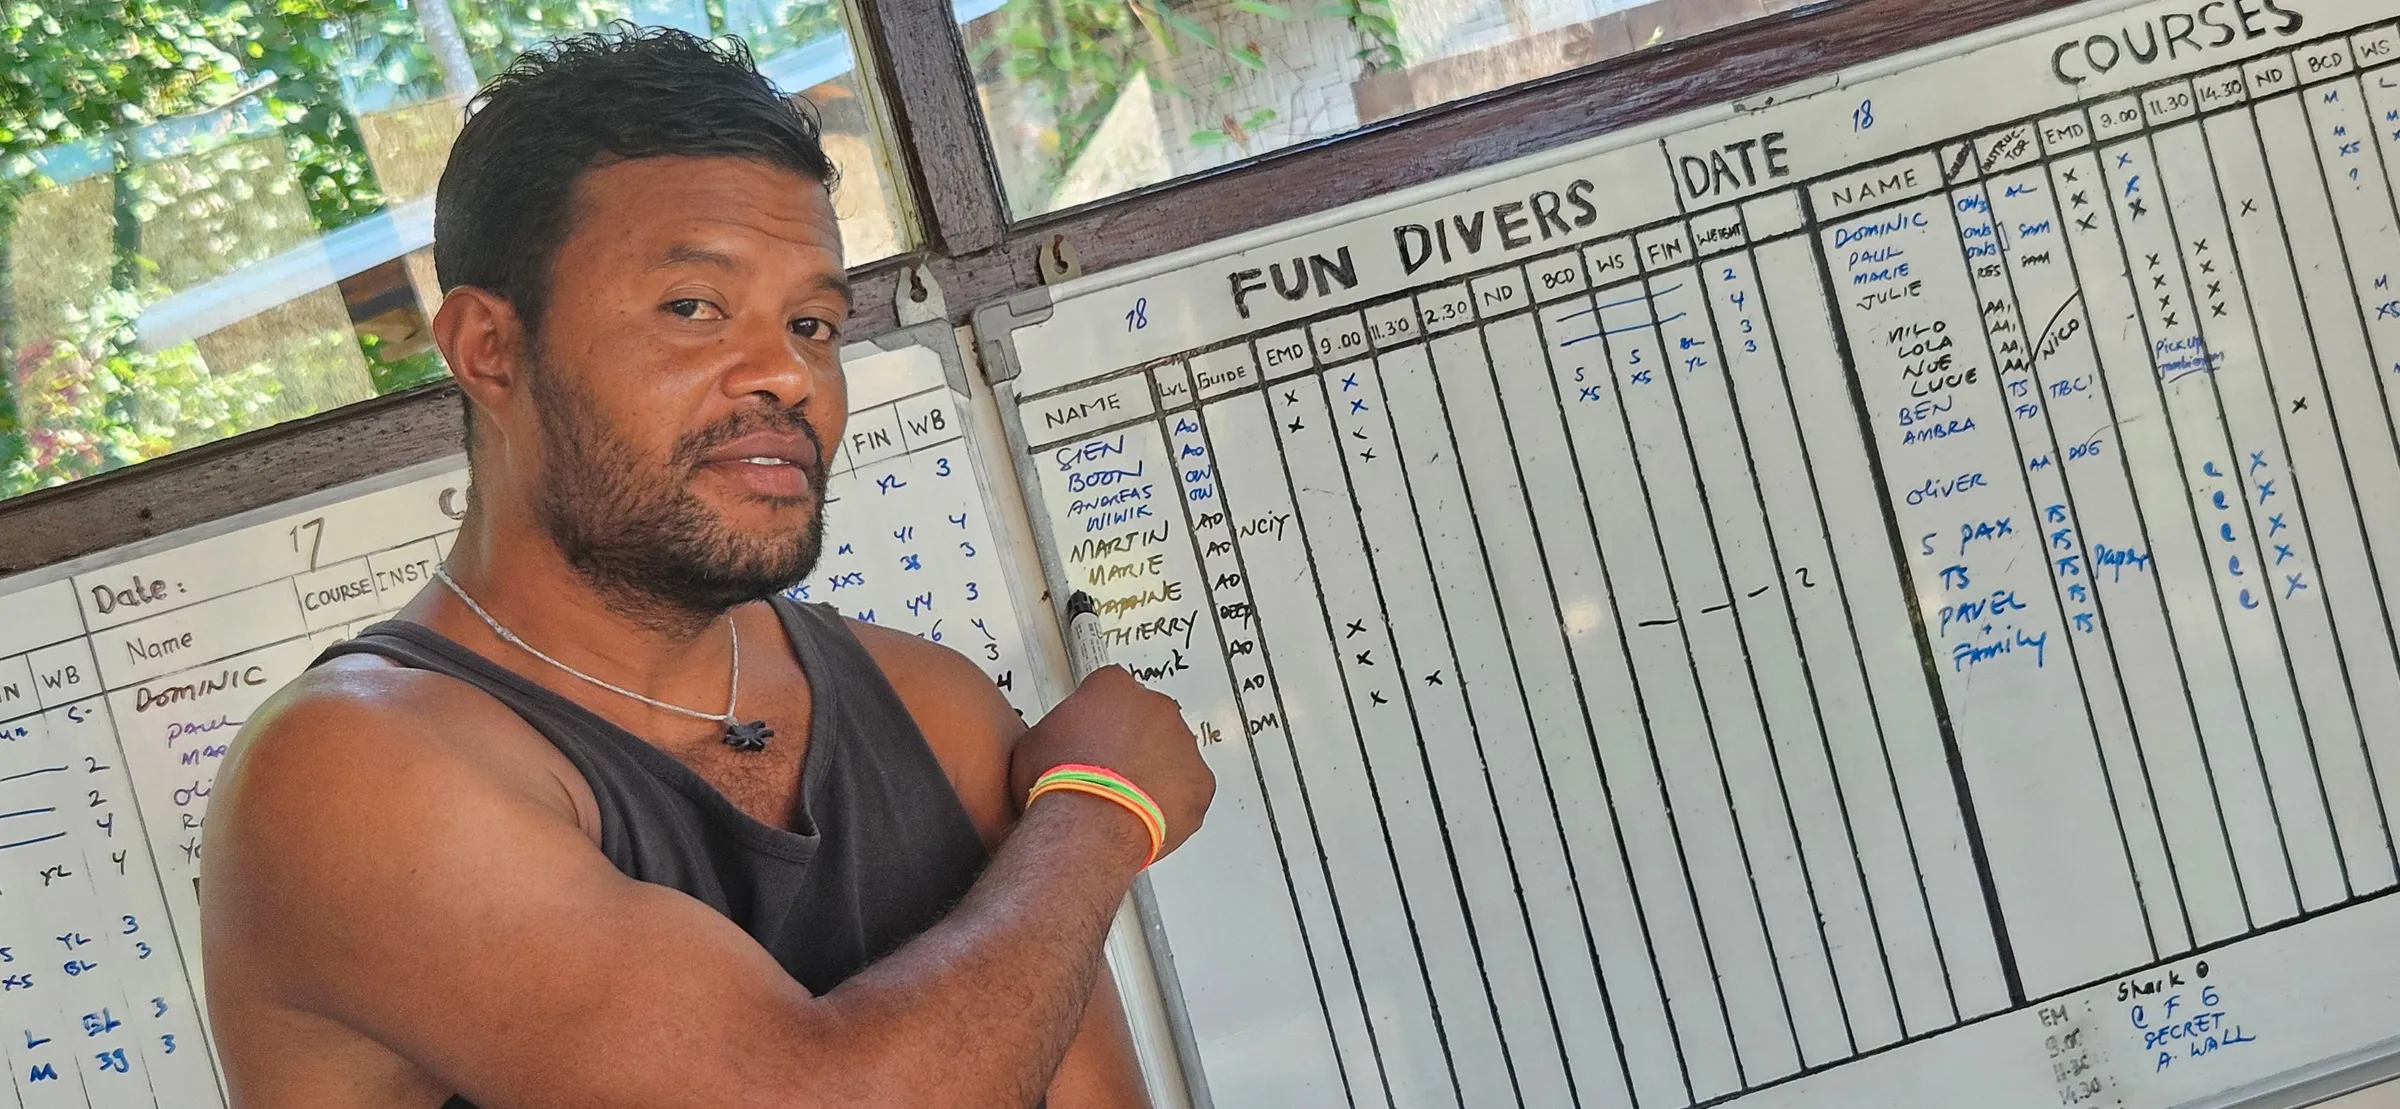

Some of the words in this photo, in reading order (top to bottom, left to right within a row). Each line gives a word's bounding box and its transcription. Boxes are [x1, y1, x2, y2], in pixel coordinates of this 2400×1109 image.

[2051, 0, 2303, 85] COURSES
[2360, 39, 2390, 58] WS
[2308, 52, 2342, 73] BCD
[2255, 69, 2283, 87] ND
[2200, 79, 2242, 103] 14.30
[2323, 90, 2339, 104] M
[2149, 92, 2189, 115] 11.30
[2386, 109, 2399, 121] M
[1853, 99, 1874, 133] 18
[2046, 123, 2083, 145] EMD
[2333, 126, 2346, 137] M
[1679, 130, 1790, 199] DATE
[1831, 169, 1918, 207] NAME
[1834, 212, 1928, 249] DOMINIC
[1227, 245, 1359, 318] FUN
[1393, 178, 1598, 276] DIVERS
[1647, 239, 1682, 264] FIN
[1848, 246, 1903, 272] PAUL
[1596, 258, 1625, 273] WS
[1723, 268, 1736, 281] 2
[1853, 262, 1909, 286] MARIE
[1542, 268, 1575, 289] BCD
[2374, 274, 2388, 291] M
[1484, 285, 1513, 307] ND
[1730, 291, 1745, 311] 4
[1856, 279, 1922, 311] JULIE
[1124, 297, 1148, 333] 18
[1424, 300, 1468, 324] 2.30
[1740, 319, 1752, 333] 3
[1267, 343, 1304, 367] EMD
[1744, 340, 1757, 352] 3
[1898, 335, 1953, 359] LOLA
[1197, 366, 1247, 391] GUIDE
[1579, 386, 1600, 402] XS
[907, 408, 946, 437] WB
[1045, 393, 1121, 429] NAME
[1899, 395, 1952, 426] BEN
[852, 428, 892, 454] FIN
[1903, 417, 1976, 446] AMBRA
[936, 458, 951, 477] 3
[1067, 485, 1153, 518] ANDREAS
[949, 512, 966, 530] 4
[290, 516, 325, 573] 17
[838, 543, 854, 555] M
[960, 541, 976, 558] 3
[1070, 520, 1168, 563] MARTIN
[1089, 554, 1163, 586] MARIE
[304, 578, 373, 611] COURSE
[965, 581, 979, 601] 3
[906, 591, 932, 617] 44
[1938, 590, 2026, 638] PAVEL
[1102, 609, 1198, 650] THIERRY
[126, 632, 193, 665] Name
[984, 643, 999, 661] 3
[41, 665, 80, 688] WB
[997, 669, 1012, 692] 4
[136, 666, 267, 712] DOMINIC
[84, 756, 110, 773] 2
[88, 790, 107, 807] 2
[96, 812, 113, 837] 4
[112, 849, 126, 875] 4
[122, 915, 139, 934] 3
[56, 932, 92, 951] YL
[135, 942, 152, 959] 3
[2117, 970, 2185, 1002] Shark
[151, 997, 168, 1018] 3
[25, 1029, 51, 1048] L
[2144, 1012, 2225, 1050] SECRET
[2191, 1025, 2256, 1057] WALL
[161, 1034, 176, 1054] 3
[30, 1063, 57, 1082] M
